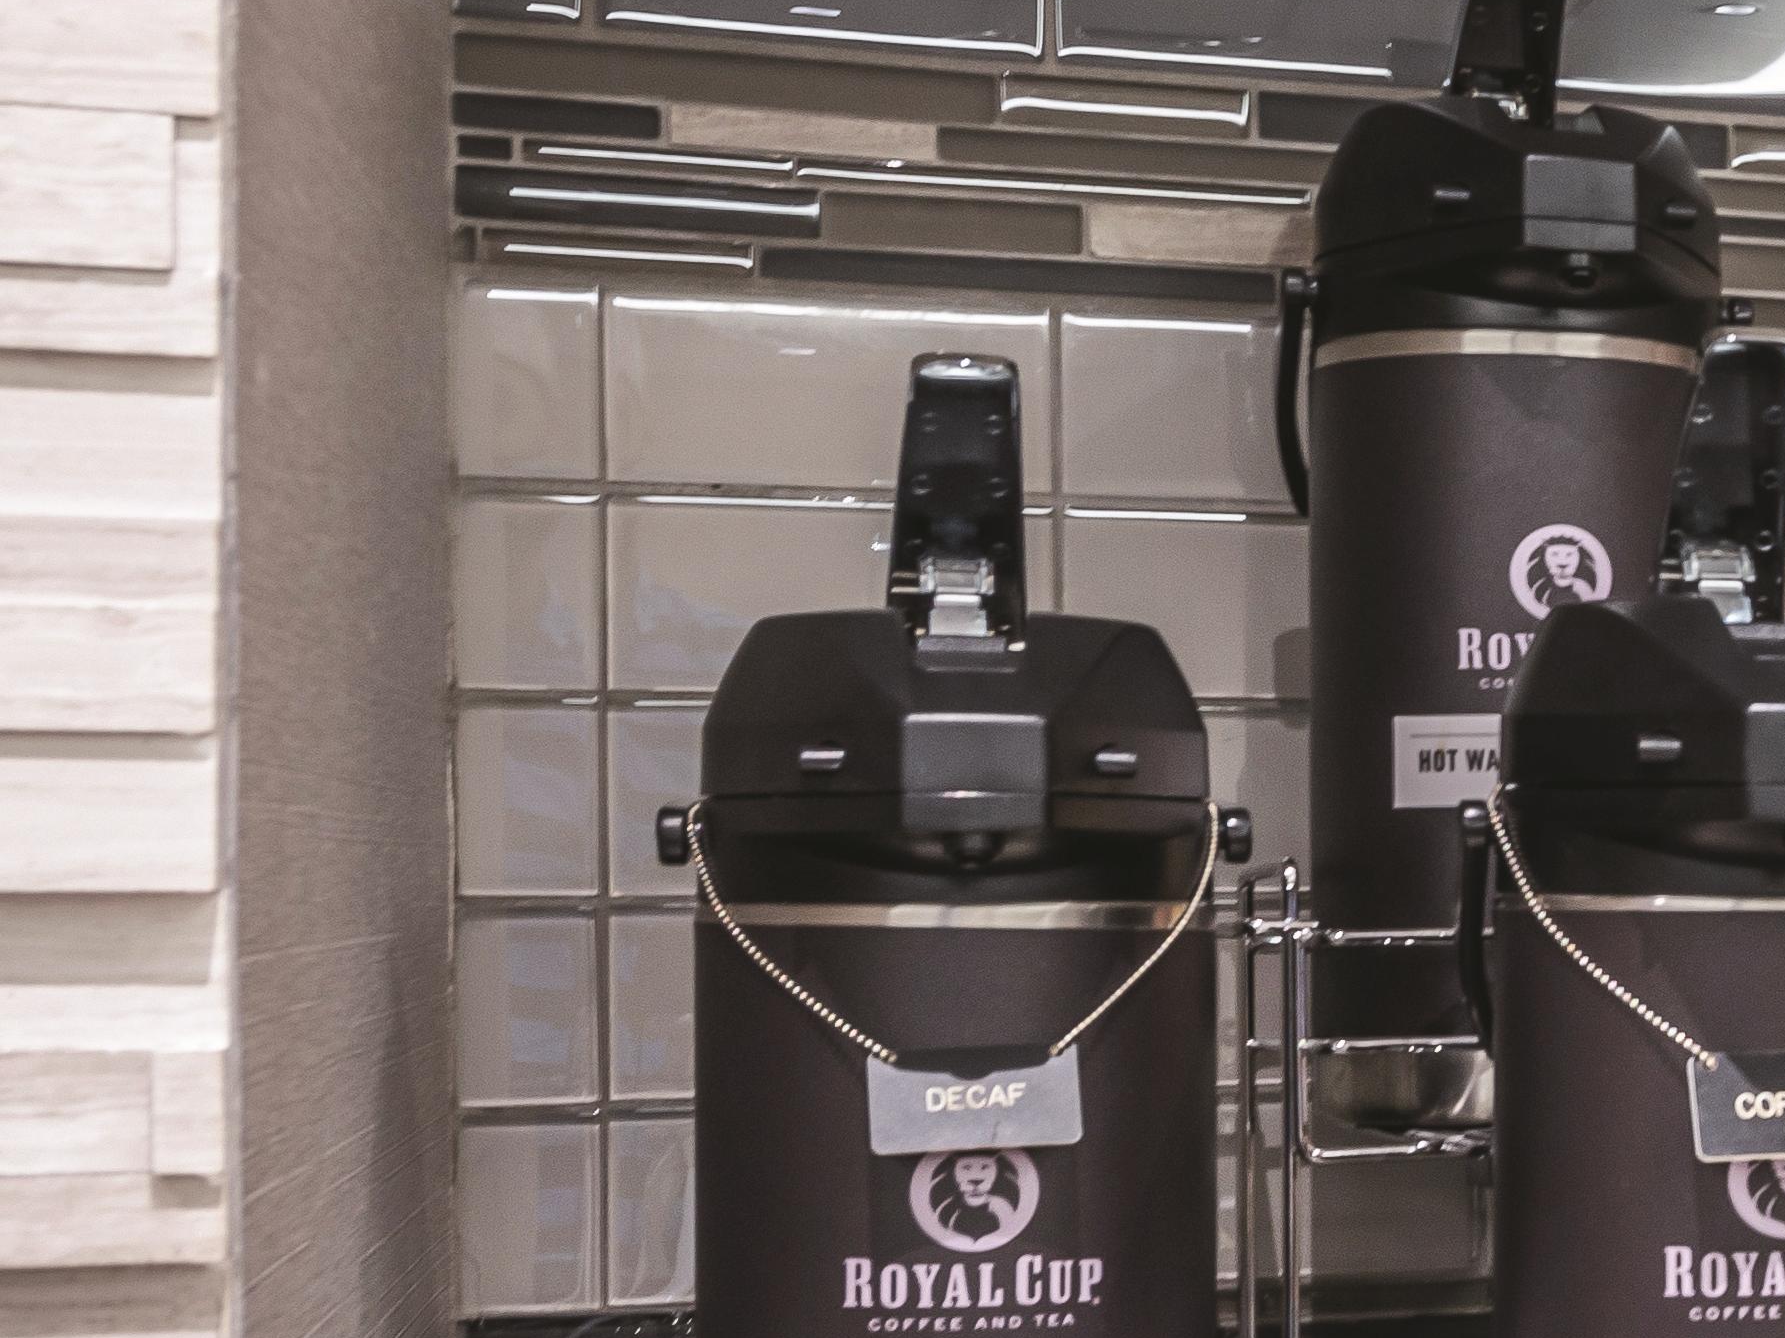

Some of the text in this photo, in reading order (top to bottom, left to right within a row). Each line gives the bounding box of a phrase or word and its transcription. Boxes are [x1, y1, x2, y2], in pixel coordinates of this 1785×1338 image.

[1458, 627, 1536, 670] ROY
[1418, 749, 1458, 773] HOT
[925, 1083, 1026, 1112] DECAF
[867, 1313, 1075, 1332] COFFEE AND TEA
[1689, 1304, 1781, 1321] COFFEE
